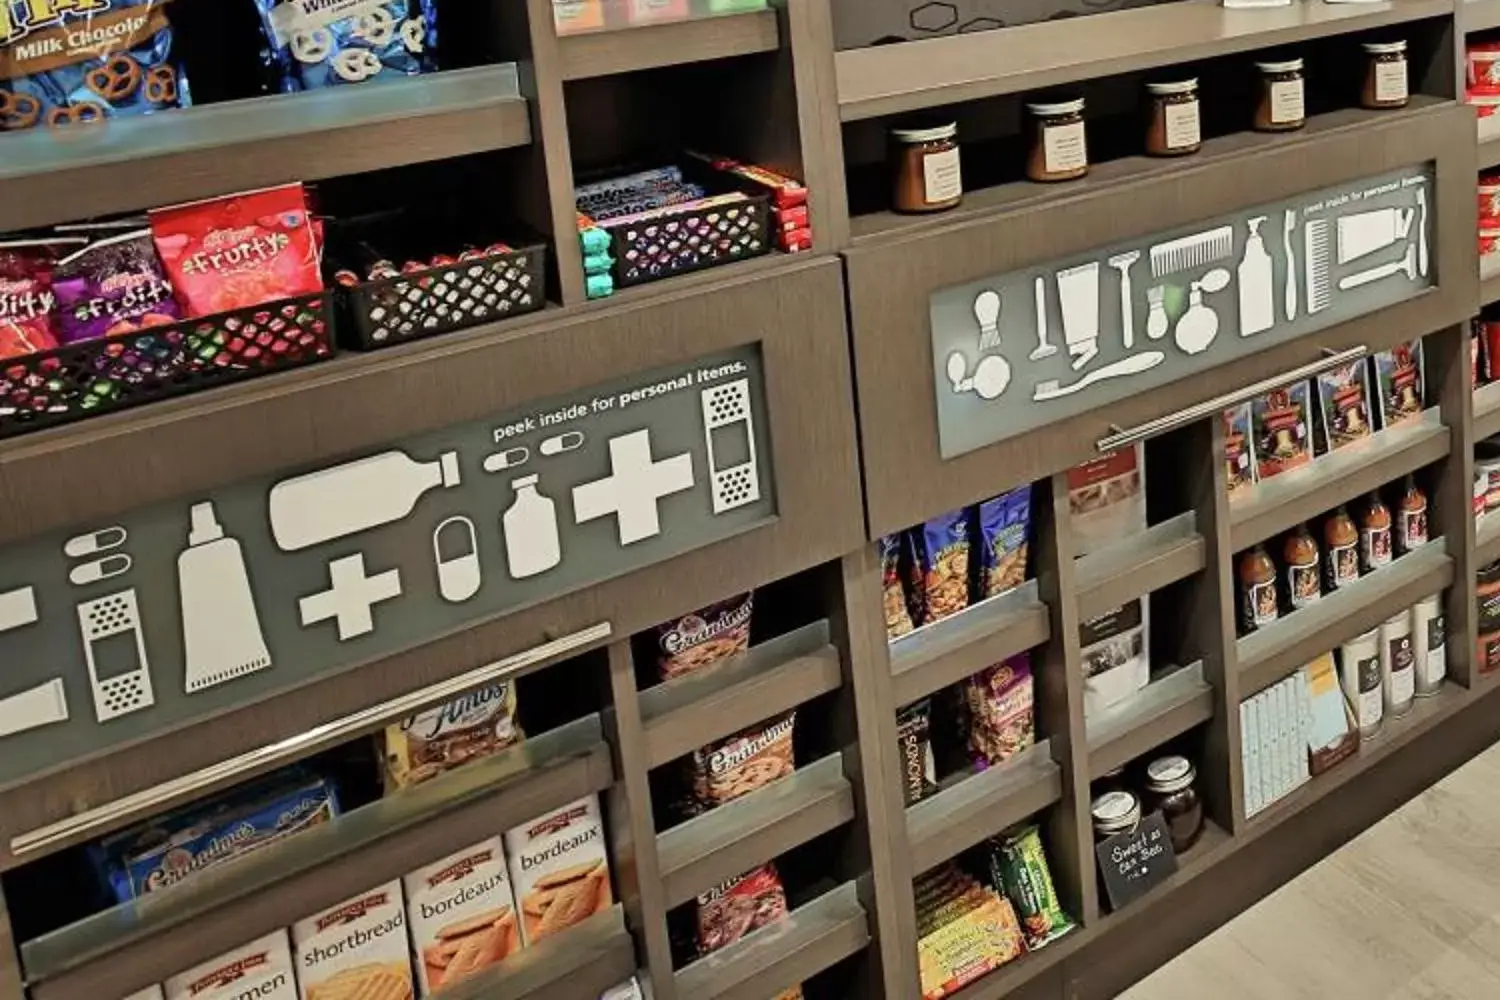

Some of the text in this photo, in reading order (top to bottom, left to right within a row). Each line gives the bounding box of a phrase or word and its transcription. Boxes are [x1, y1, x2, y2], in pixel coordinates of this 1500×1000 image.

[15, 38, 63, 62] Milk
[66, 14, 148, 48] Chocola
[576, 185, 636, 206] entos
[597, 200, 659, 220] entos
[193, 232, 281, 274] Fruity
[0, 289, 55, 317] ity
[493, 360, 748, 443] peek inside for personal items.
[519, 824, 600, 872] bordeaux
[420, 871, 505, 921] bordeaux
[303, 910, 403, 969] shortbread
